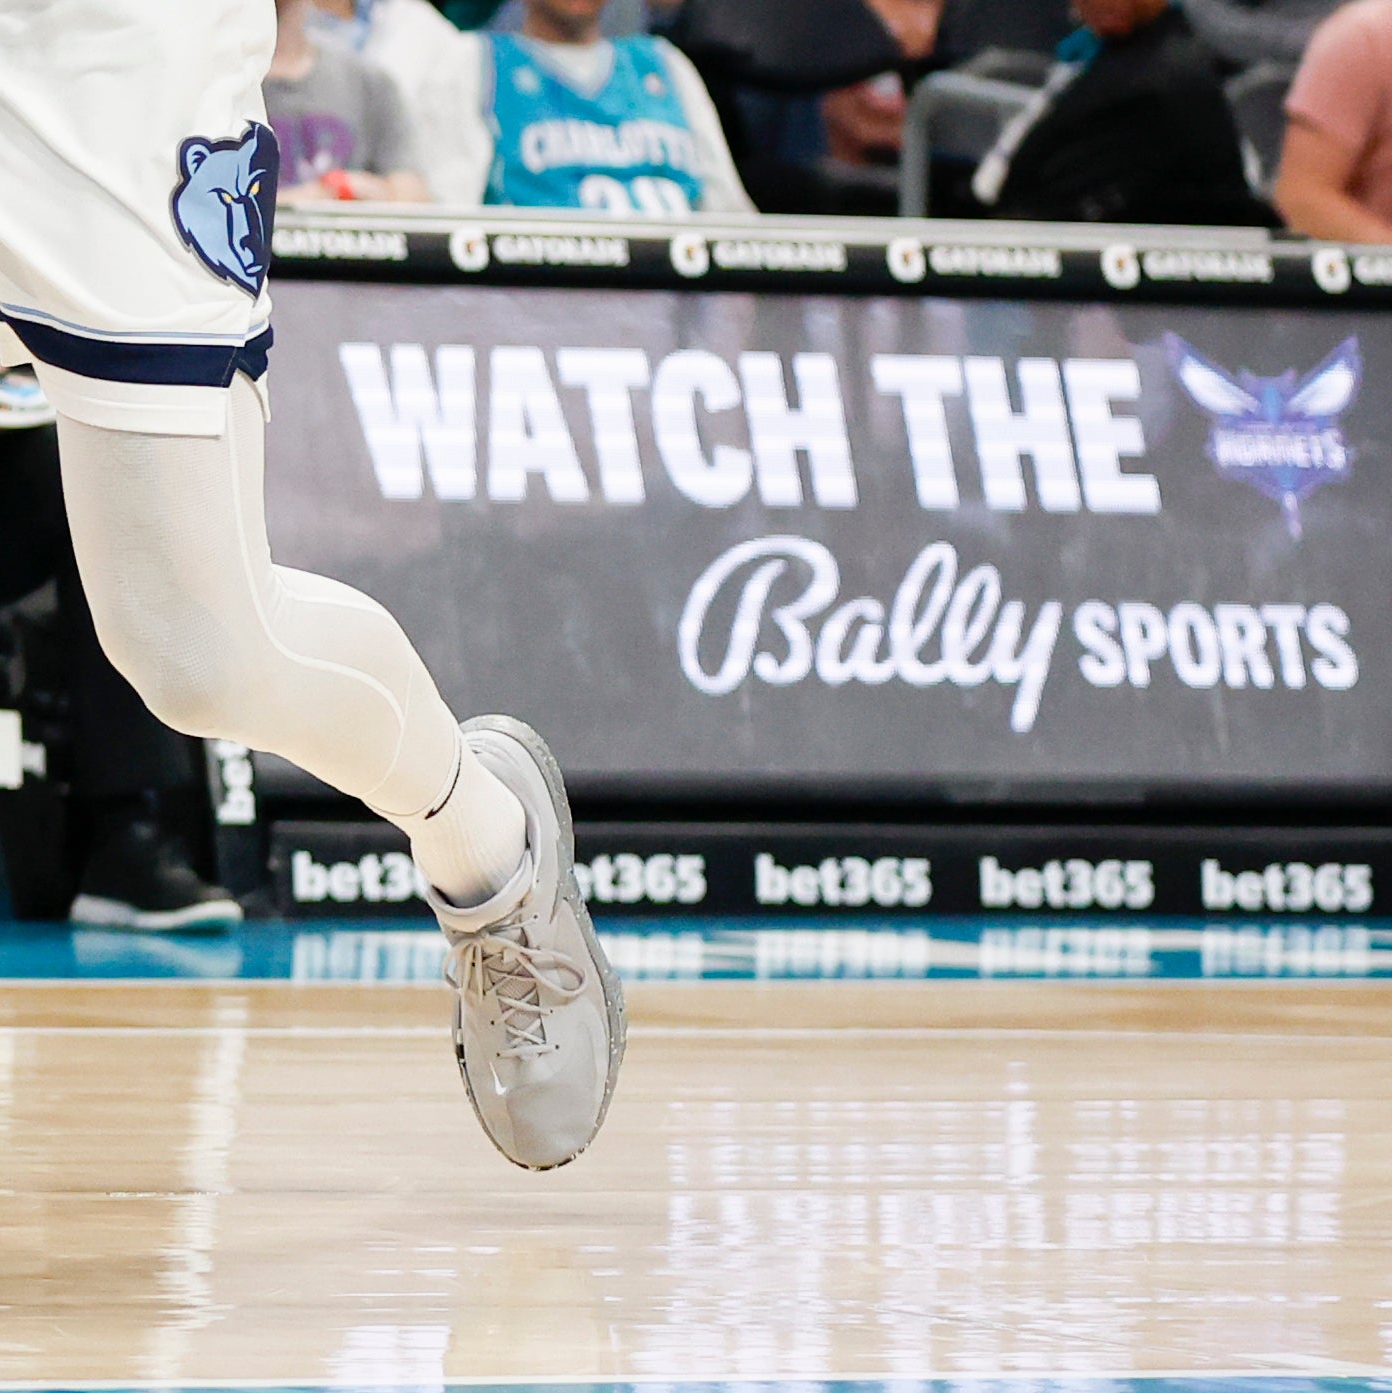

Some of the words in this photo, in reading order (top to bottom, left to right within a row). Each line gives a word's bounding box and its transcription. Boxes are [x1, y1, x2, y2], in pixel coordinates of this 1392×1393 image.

[337, 341, 858, 511] WATCH
[870, 352, 1163, 516] THE
[676, 533, 1061, 734] Bally
[1076, 599, 1360, 692] SPORTS
[754, 851, 933, 907] bet365
[978, 855, 1156, 910] bet365
[1201, 858, 1375, 913] bet365
